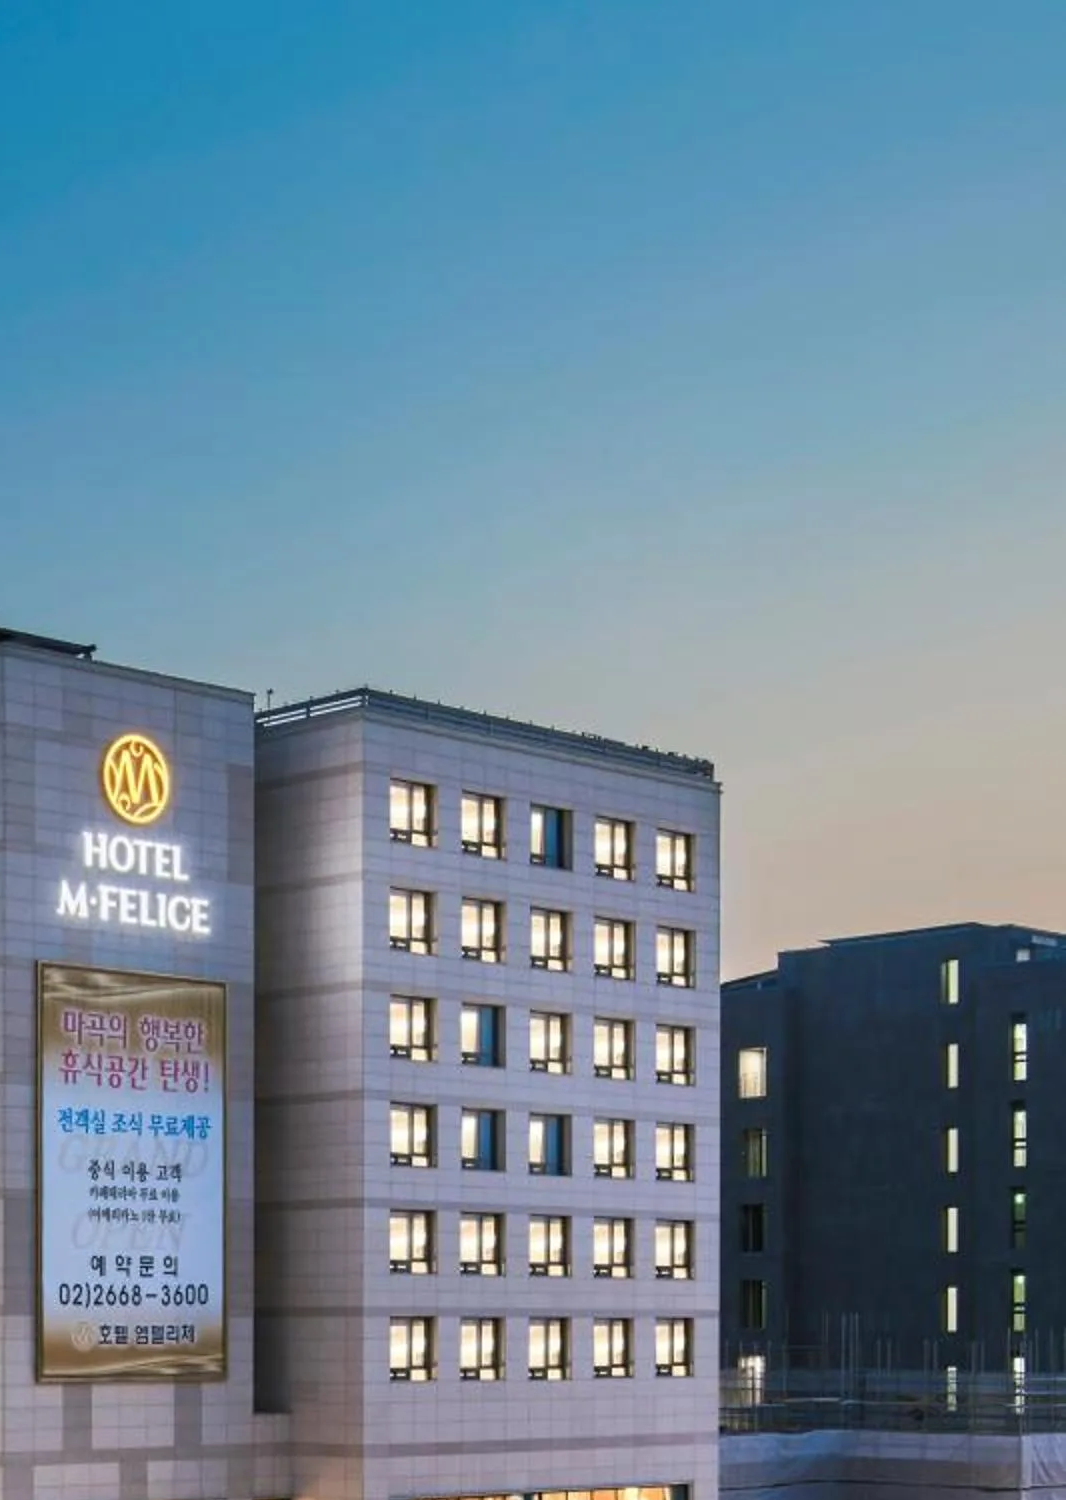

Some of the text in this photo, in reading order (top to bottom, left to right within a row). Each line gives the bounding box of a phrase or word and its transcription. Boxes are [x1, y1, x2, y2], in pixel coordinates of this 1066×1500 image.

[82, 830, 190, 881] HOTEL
[63, 1010, 203, 1054] 마곡의 행복한
[59, 1049, 209, 1094] 휴식공간 탄생!
[58, 1107, 212, 1140] 전객실 조식 무료제공
[121, 1160, 150, 1183] 이용
[156, 1163, 183, 1183] 고객
[58, 1282, 210, 1308] 02)2668-3600
[98, 1323, 129, 1345] 호텔
